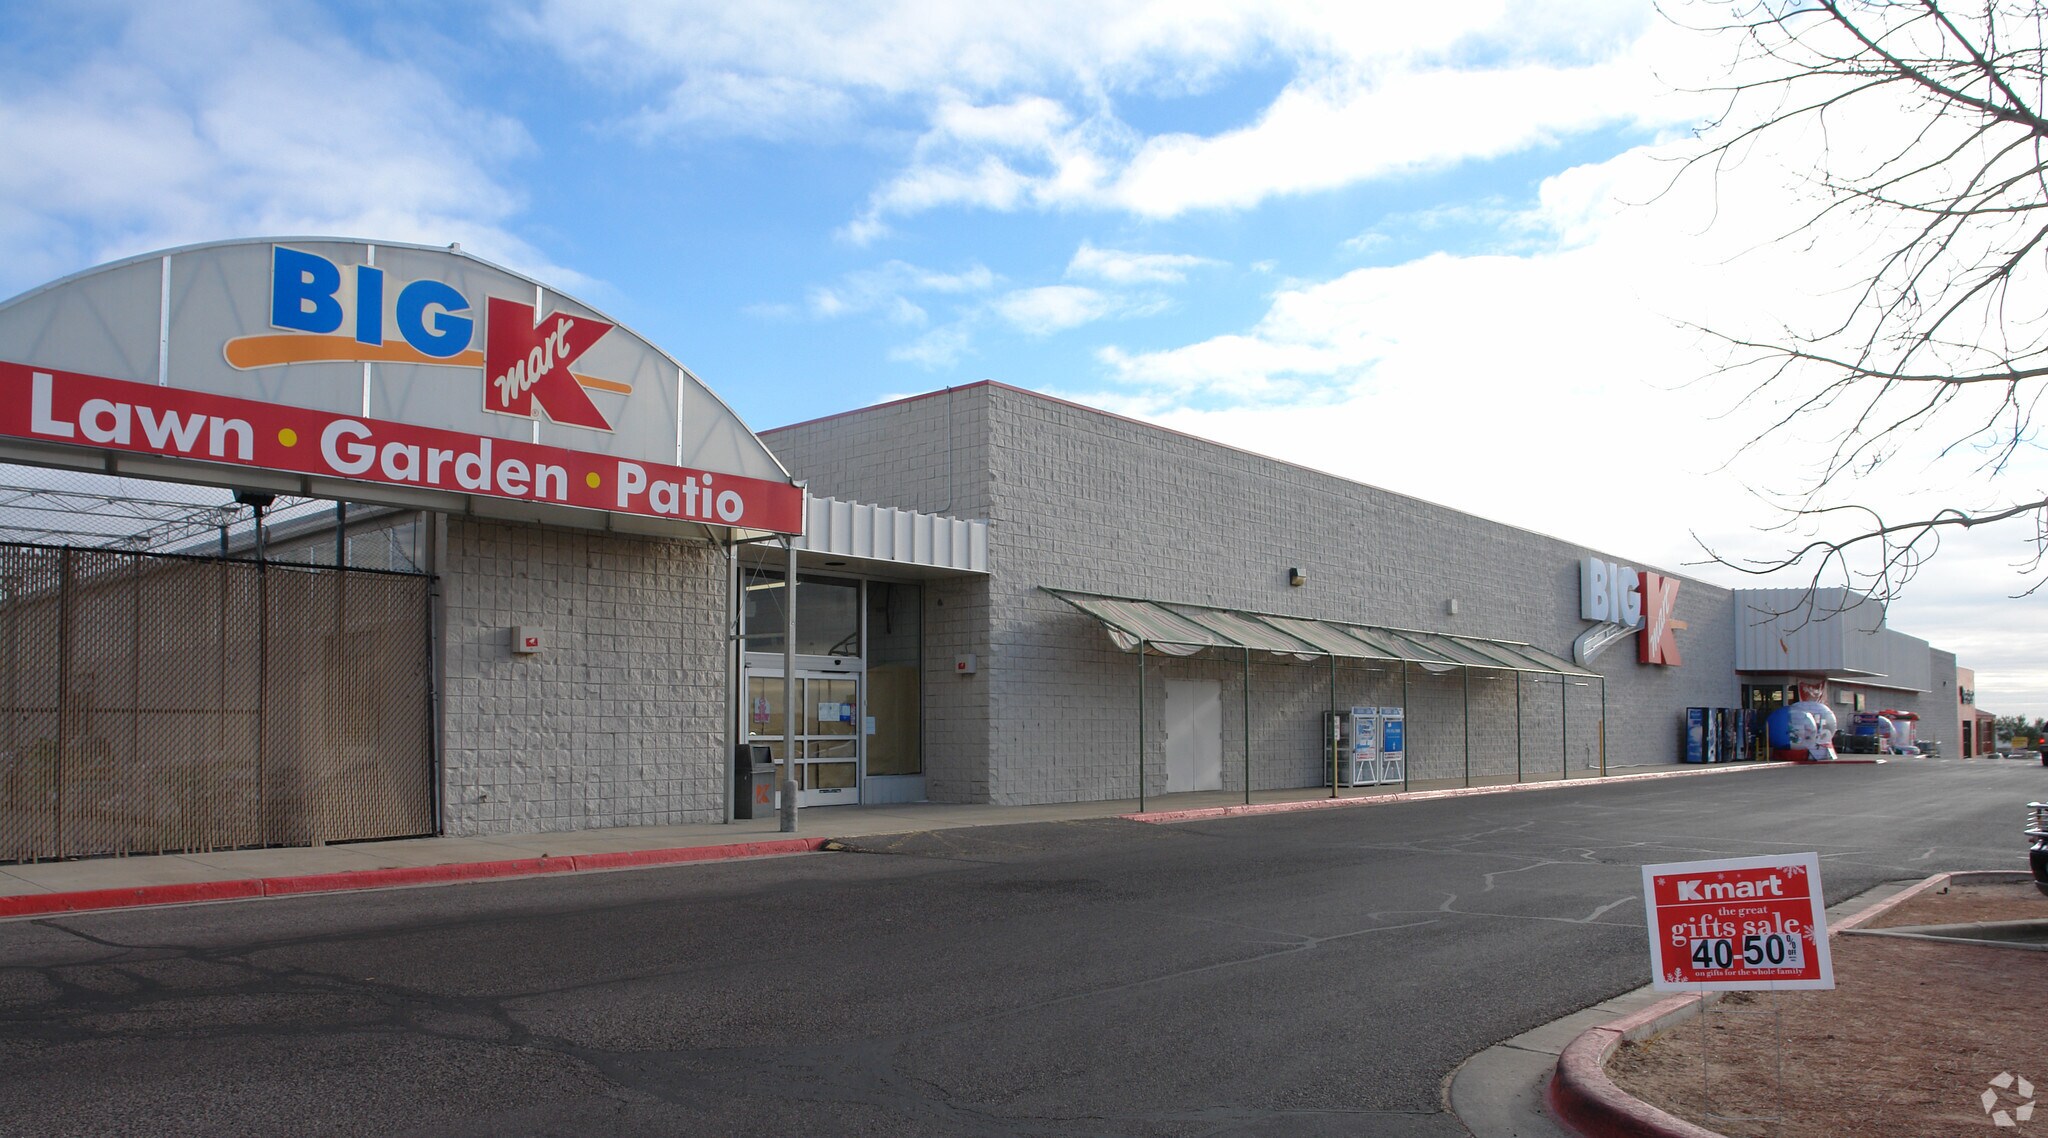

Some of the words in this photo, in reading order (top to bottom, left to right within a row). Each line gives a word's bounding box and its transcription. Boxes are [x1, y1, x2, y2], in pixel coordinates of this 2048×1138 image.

[272, 245, 475, 359] BIG
[494, 317, 574, 409] mart
[31, 371, 254, 461] Lawn
[320, 418, 568, 501] Garden
[617, 460, 744, 522] Patio
[1580, 556, 1642, 628] BIG
[1677, 874, 1783, 902] Kmart
[1718, 907, 1736, 917] the
[1738, 905, 1768, 918] great
[1671, 913, 1737, 948] gifts
[1743, 911, 1800, 936] sale
[1707, 969, 1724, 978] gifts
[1752, 968, 1776, 976] whole
[1777, 967, 1803, 976] family
